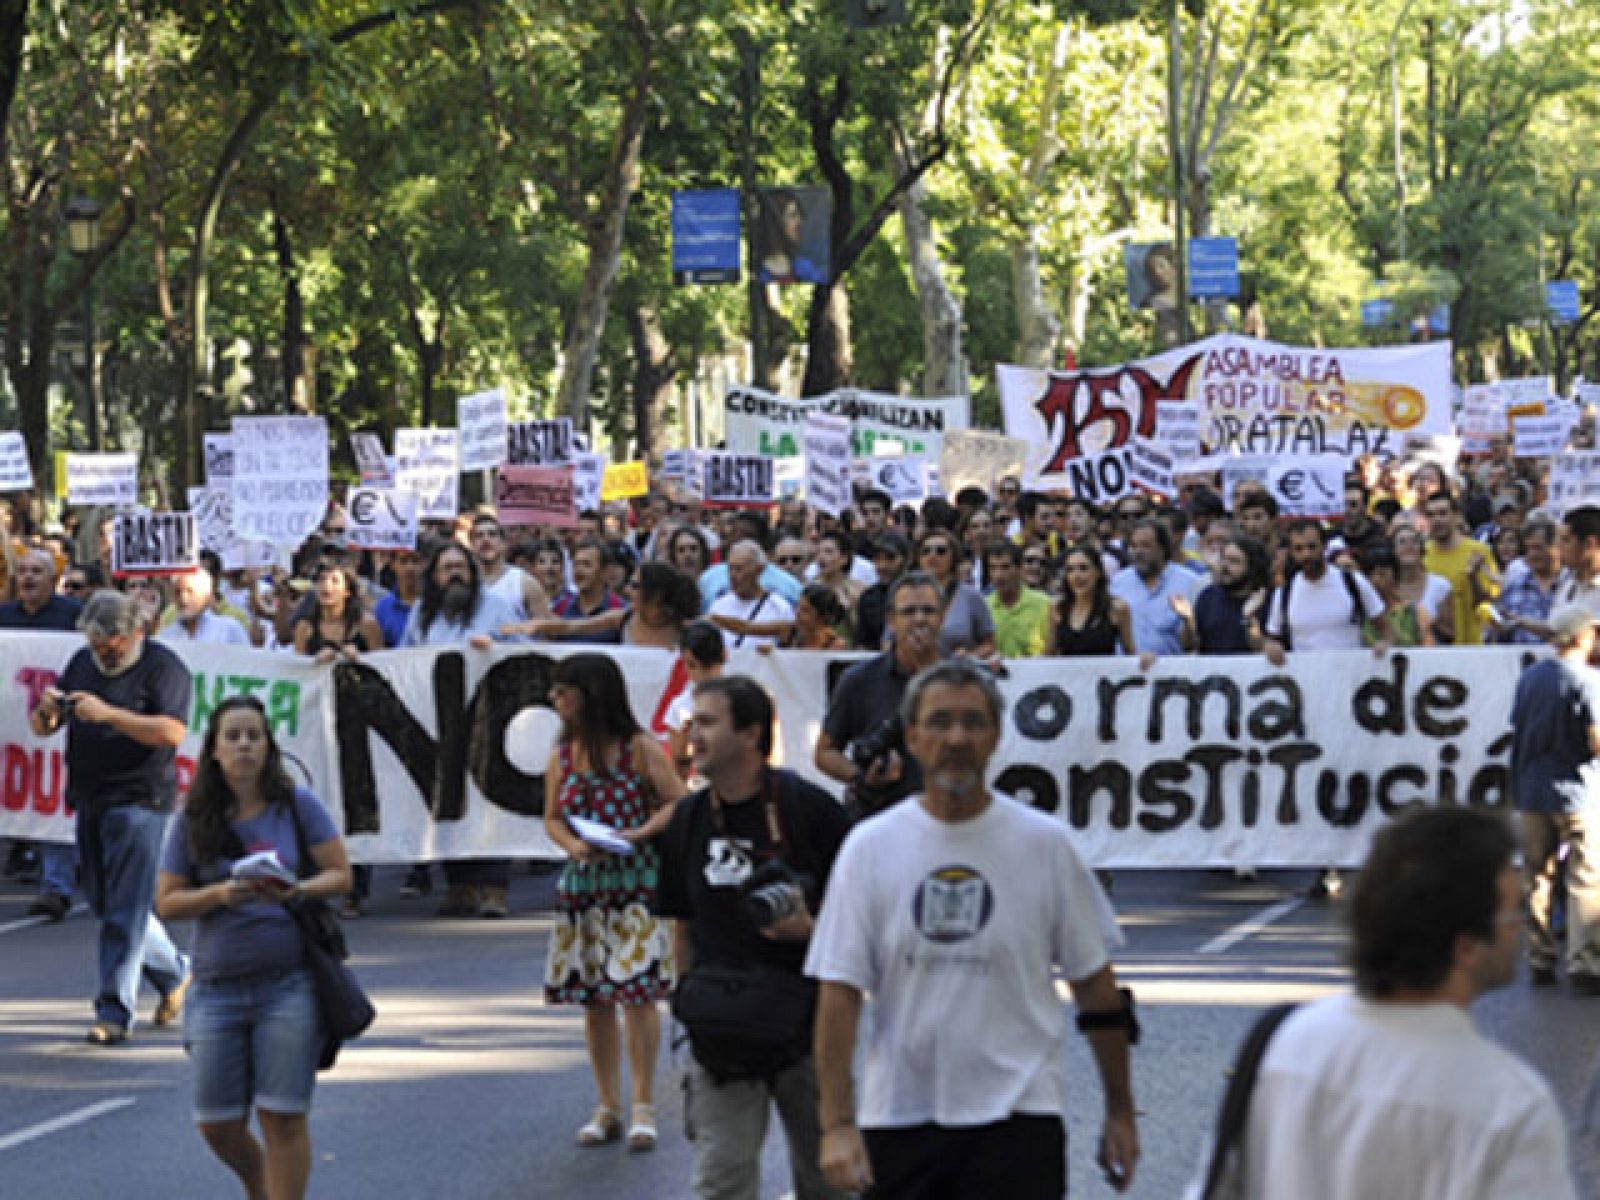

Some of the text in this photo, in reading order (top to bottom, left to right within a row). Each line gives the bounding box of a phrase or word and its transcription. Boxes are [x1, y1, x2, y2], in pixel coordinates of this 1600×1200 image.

[1203, 347, 1346, 386] ASAMBLEA
[1204, 382, 1346, 416] POPULAR
[759, 429, 799, 457] LA
[1207, 412, 1396, 460] ORATALAZ
[1352, 652, 1471, 739] de
[333, 650, 558, 835] NO
